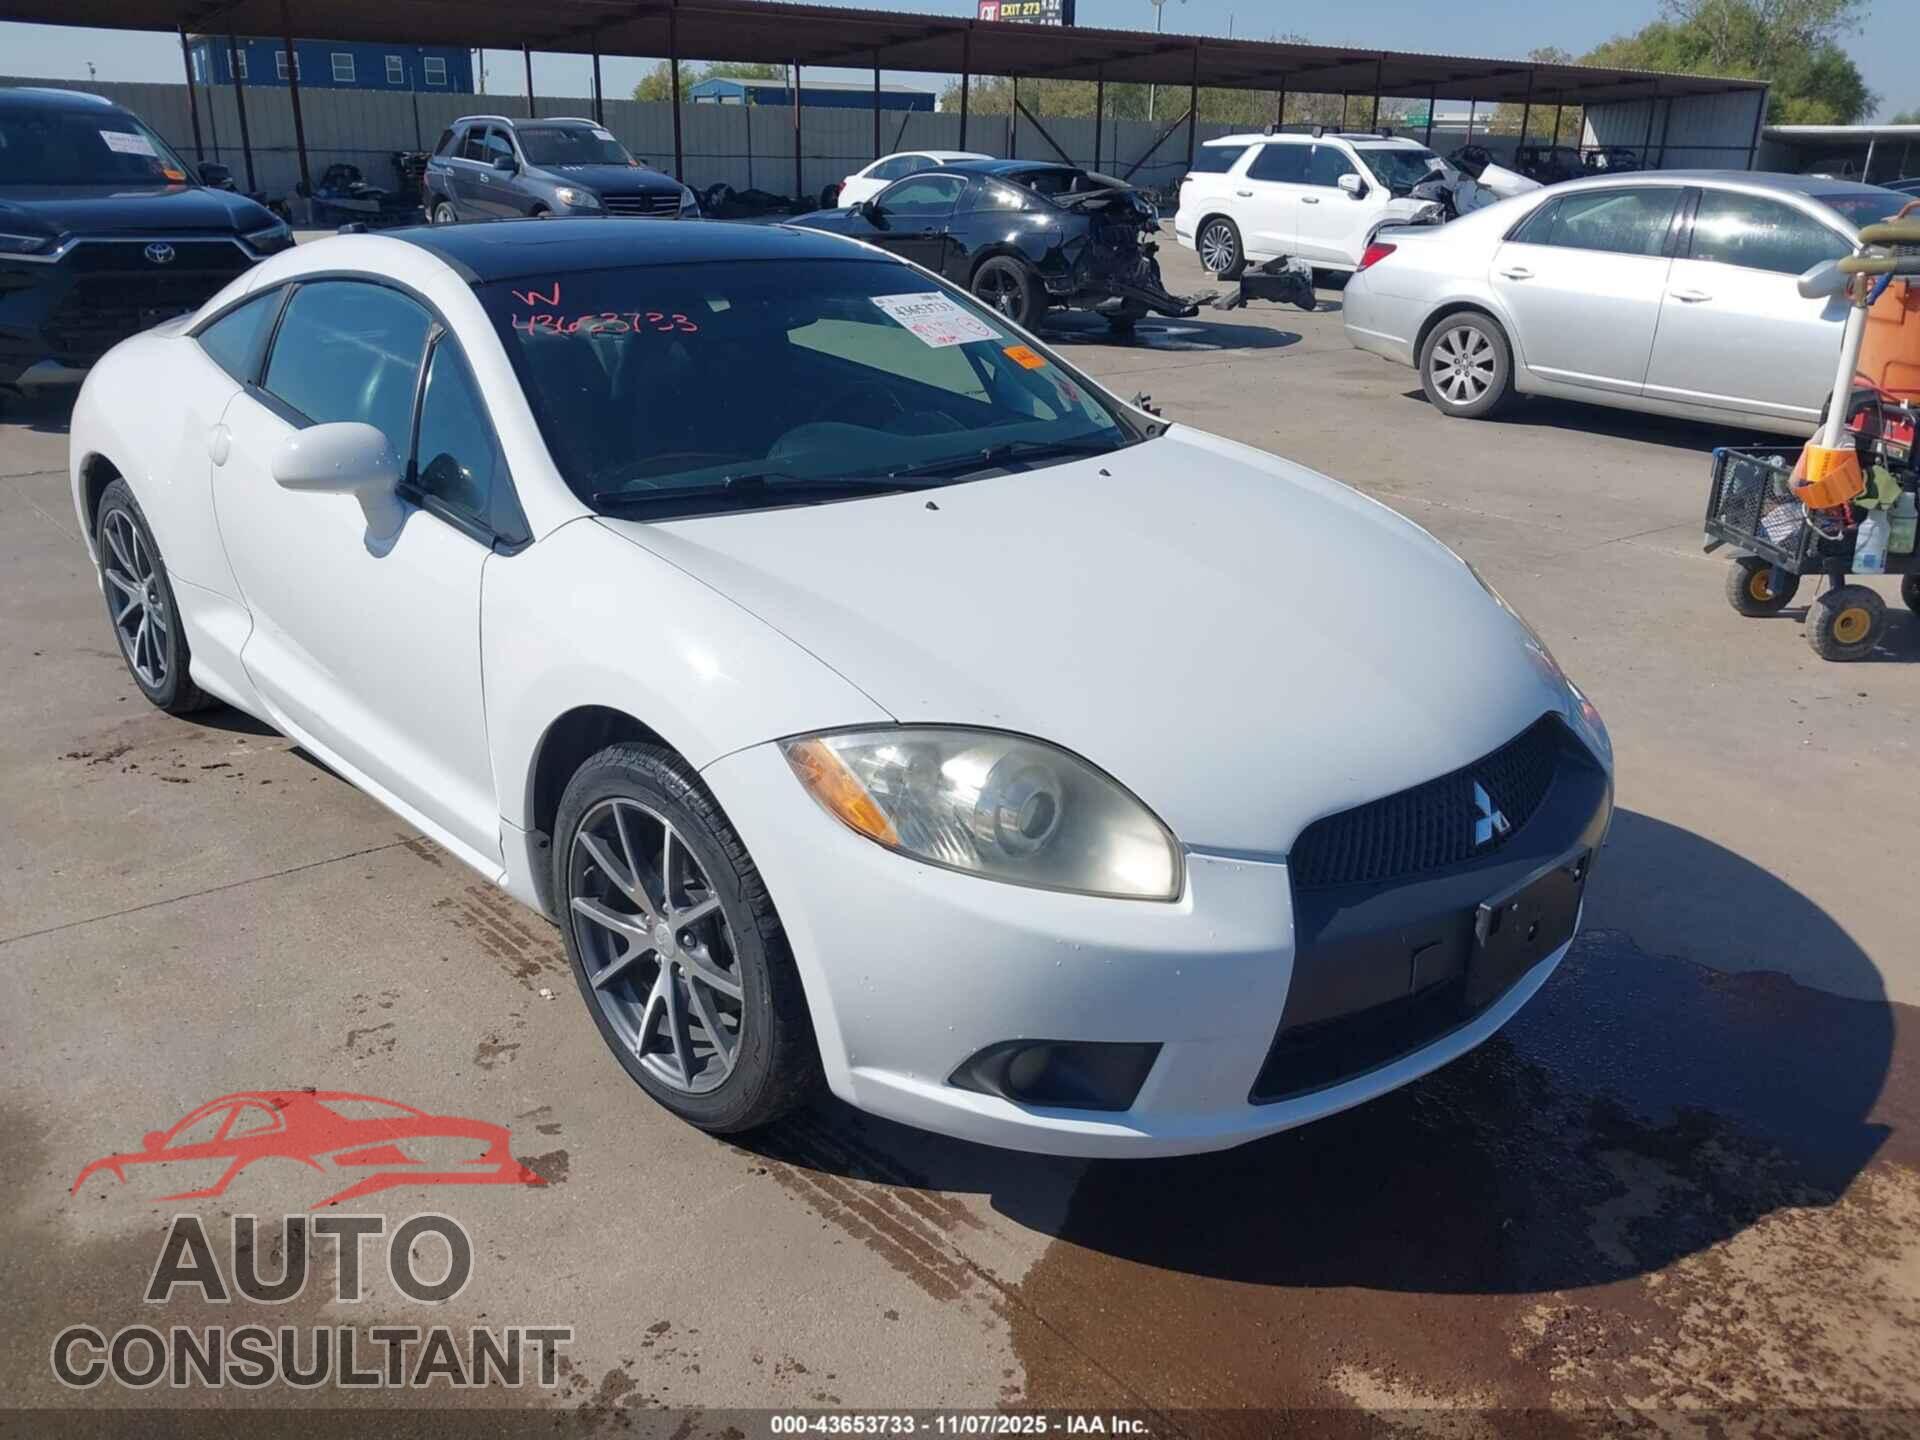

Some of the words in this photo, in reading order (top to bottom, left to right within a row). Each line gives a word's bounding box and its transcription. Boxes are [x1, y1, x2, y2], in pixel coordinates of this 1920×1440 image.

[1000, 4, 1020, 16] EXIT
[1023, 2, 1040, 15] 273
[512, 282, 560, 306] W
